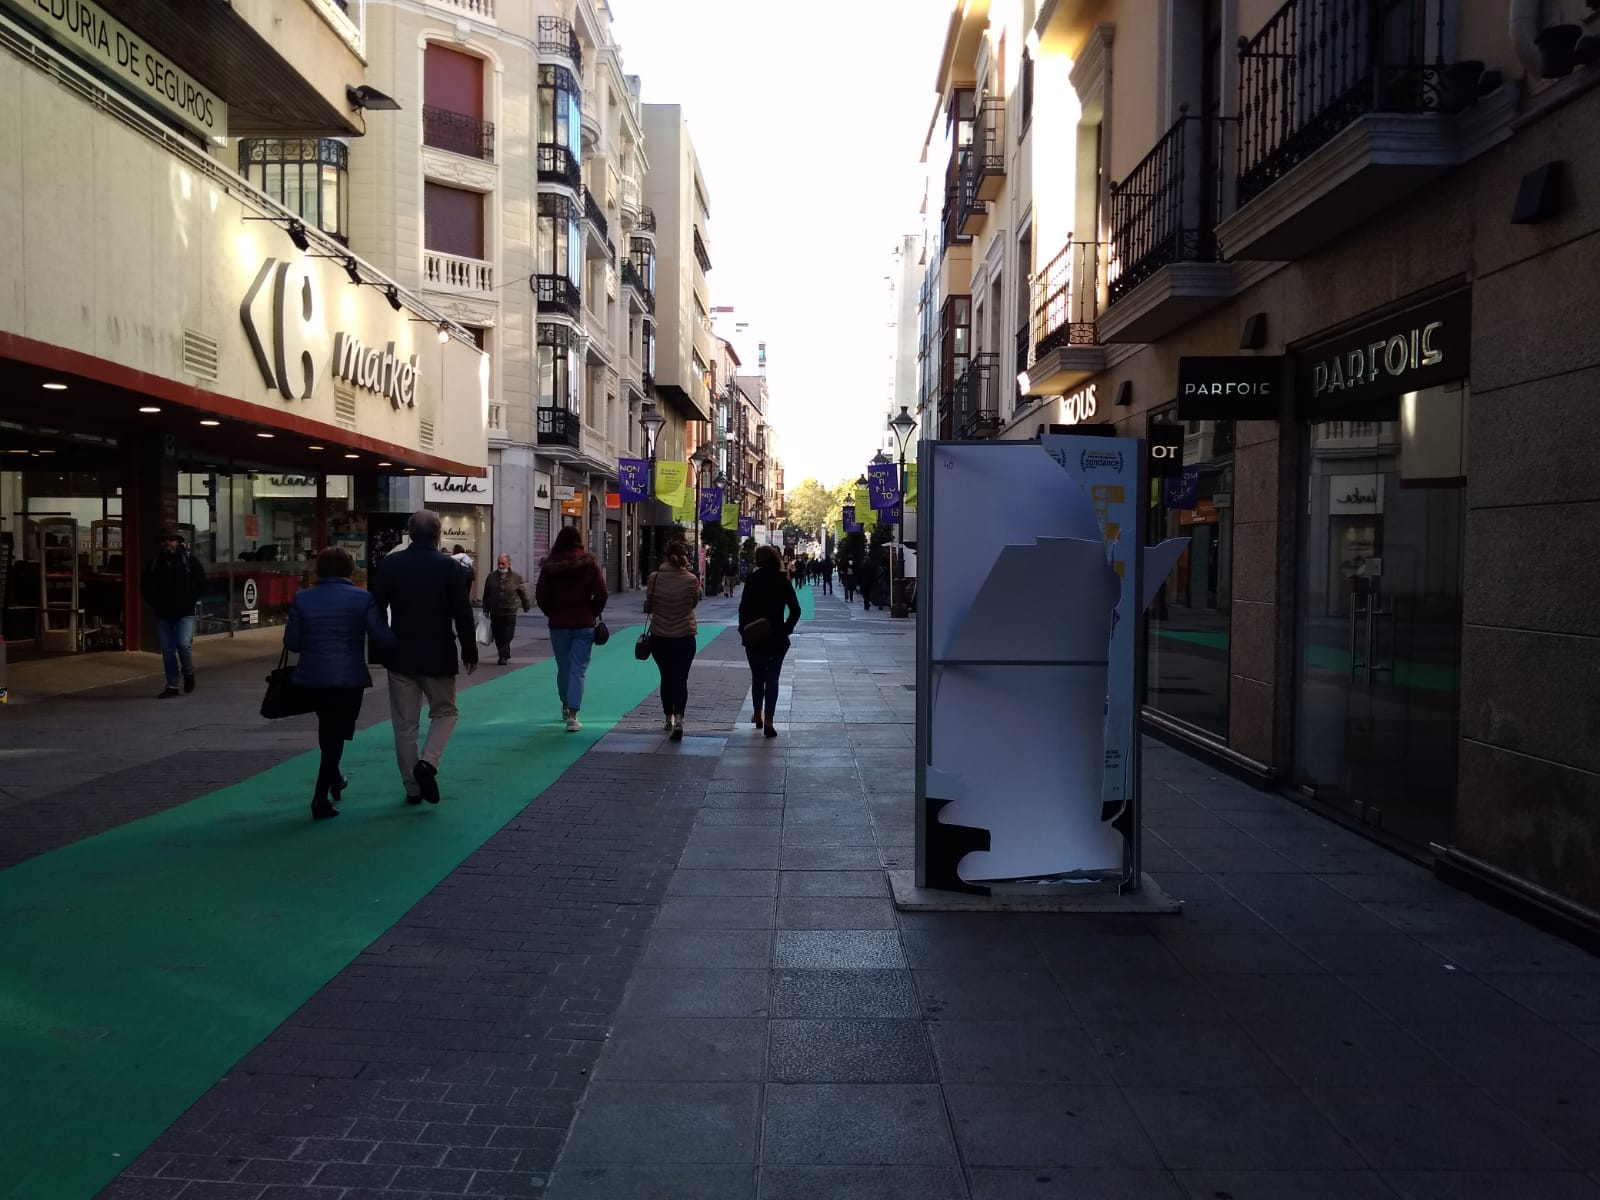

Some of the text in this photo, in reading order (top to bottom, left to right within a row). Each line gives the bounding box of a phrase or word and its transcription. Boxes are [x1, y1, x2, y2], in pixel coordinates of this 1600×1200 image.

[116, 32, 140, 77] DE
[145, 54, 214, 127] SEGUROS
[333, 331, 422, 409] market
[1313, 320, 1443, 398] PARFOIS
[1185, 382, 1271, 395] PARFOIS
[1151, 445, 1179, 459] OT
[432, 475, 487, 493] ulanka
